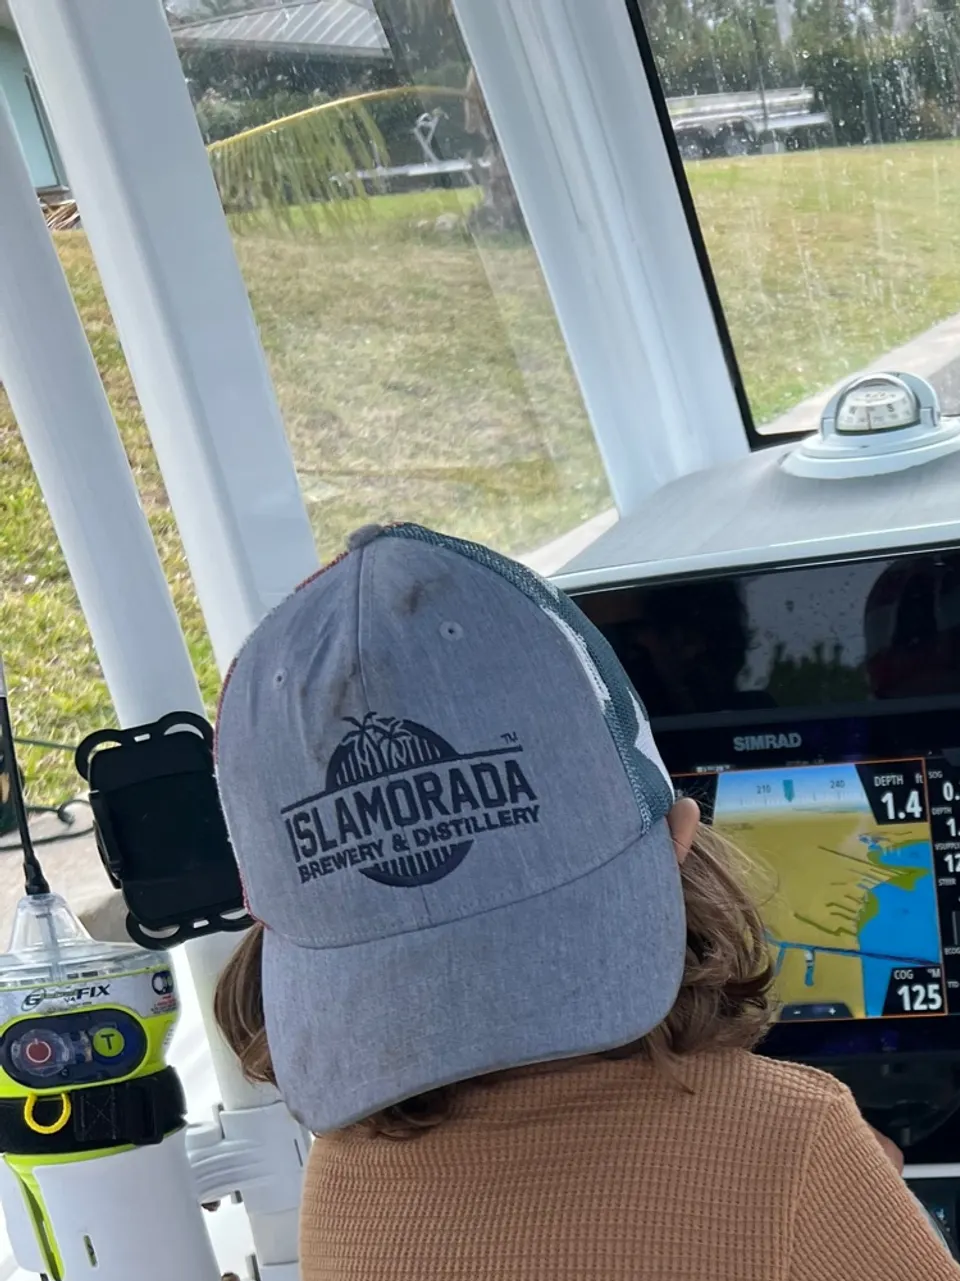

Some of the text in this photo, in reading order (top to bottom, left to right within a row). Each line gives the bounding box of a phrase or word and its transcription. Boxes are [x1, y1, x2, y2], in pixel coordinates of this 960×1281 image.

[733, 733, 801, 752] SIMRAD
[756, 784, 771, 794] 210
[830, 779, 845, 789] 240
[874, 774, 923, 786] DEPTH ft
[285, 759, 538, 863] ISLAMORADA
[880, 790, 922, 820] 1.4
[297, 804, 542, 884] BREWERY & DISTILLERY
[894, 969, 914, 980] COG
[897, 984, 942, 1011] 125
[101, 1033, 115, 1050] T
